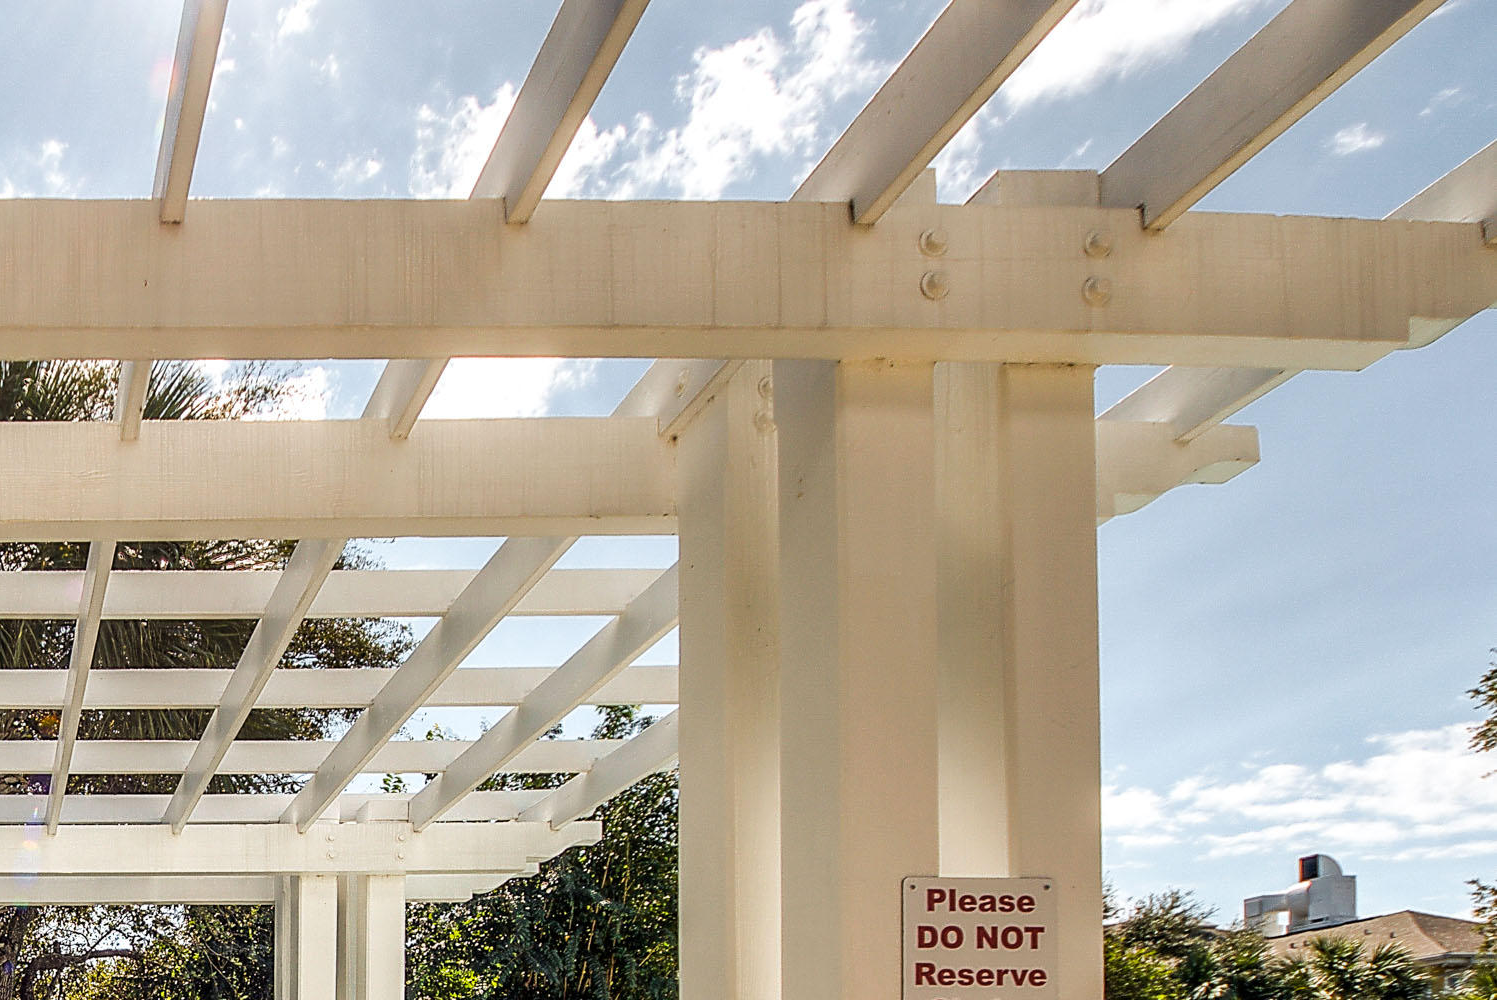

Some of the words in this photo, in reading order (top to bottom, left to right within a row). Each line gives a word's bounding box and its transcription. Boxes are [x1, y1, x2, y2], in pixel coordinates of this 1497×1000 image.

[926, 889, 1035, 912] Please
[917, 926, 964, 949] DO
[976, 926, 1045, 950] NOT
[915, 963, 1047, 986] Reserve
